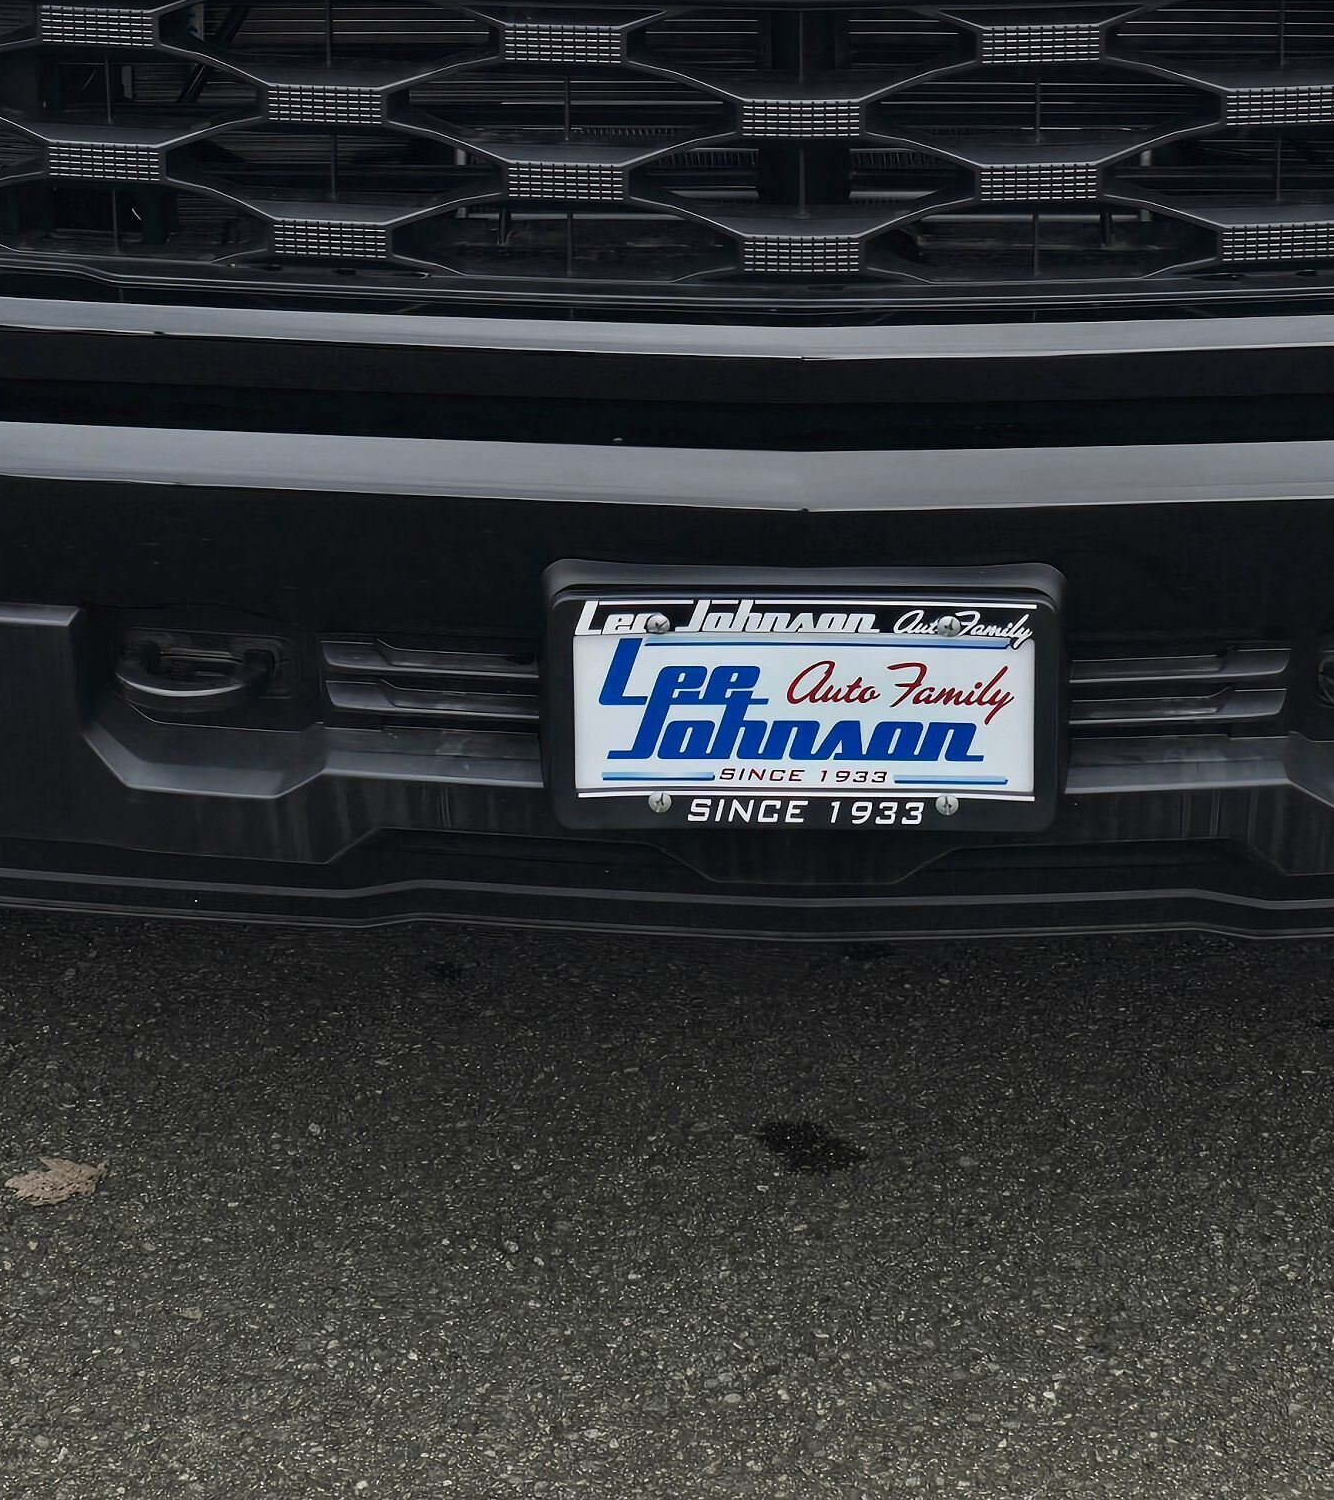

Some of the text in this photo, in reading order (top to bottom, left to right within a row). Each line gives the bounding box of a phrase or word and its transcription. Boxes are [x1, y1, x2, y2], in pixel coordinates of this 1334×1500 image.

[674, 600, 880, 633] Johnson
[893, 610, 944, 635] Aut
[955, 611, 1033, 649] Family
[598, 638, 768, 706] Lee
[786, 660, 1014, 725] Auto Family
[607, 703, 984, 761] Johnson
[719, 768, 888, 783] SINCE 1933
[687, 798, 925, 825] SINCE 1933
